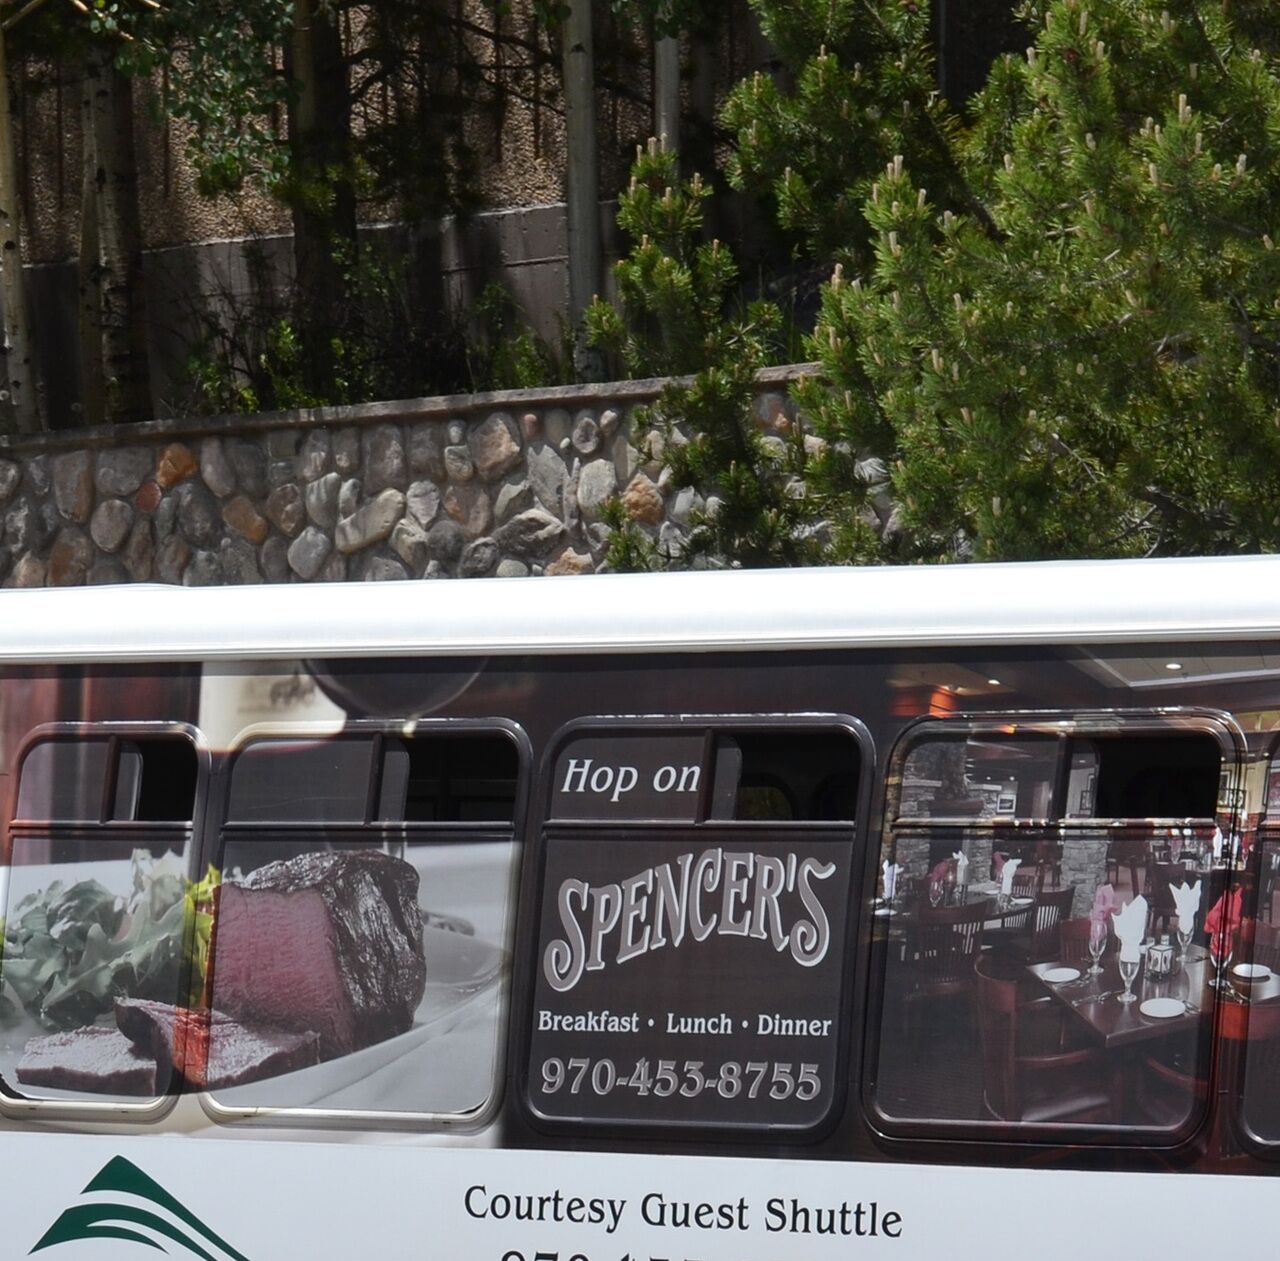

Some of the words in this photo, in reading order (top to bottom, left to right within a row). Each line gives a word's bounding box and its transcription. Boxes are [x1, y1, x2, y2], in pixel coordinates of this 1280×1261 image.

[561, 759, 638, 801] Hop
[653, 764, 701, 792] on
[543, 848, 836, 992] SPENCER'S
[538, 1011, 639, 1032] Breakfast
[666, 1013, 732, 1034] Lunch
[758, 1014, 831, 1036] Dinner
[541, 1057, 821, 1100] 970-453-8755
[464, 1185, 626, 1233] Courtesy
[641, 1193, 750, 1231] Guest
[765, 1199, 903, 1238] Shuttle
